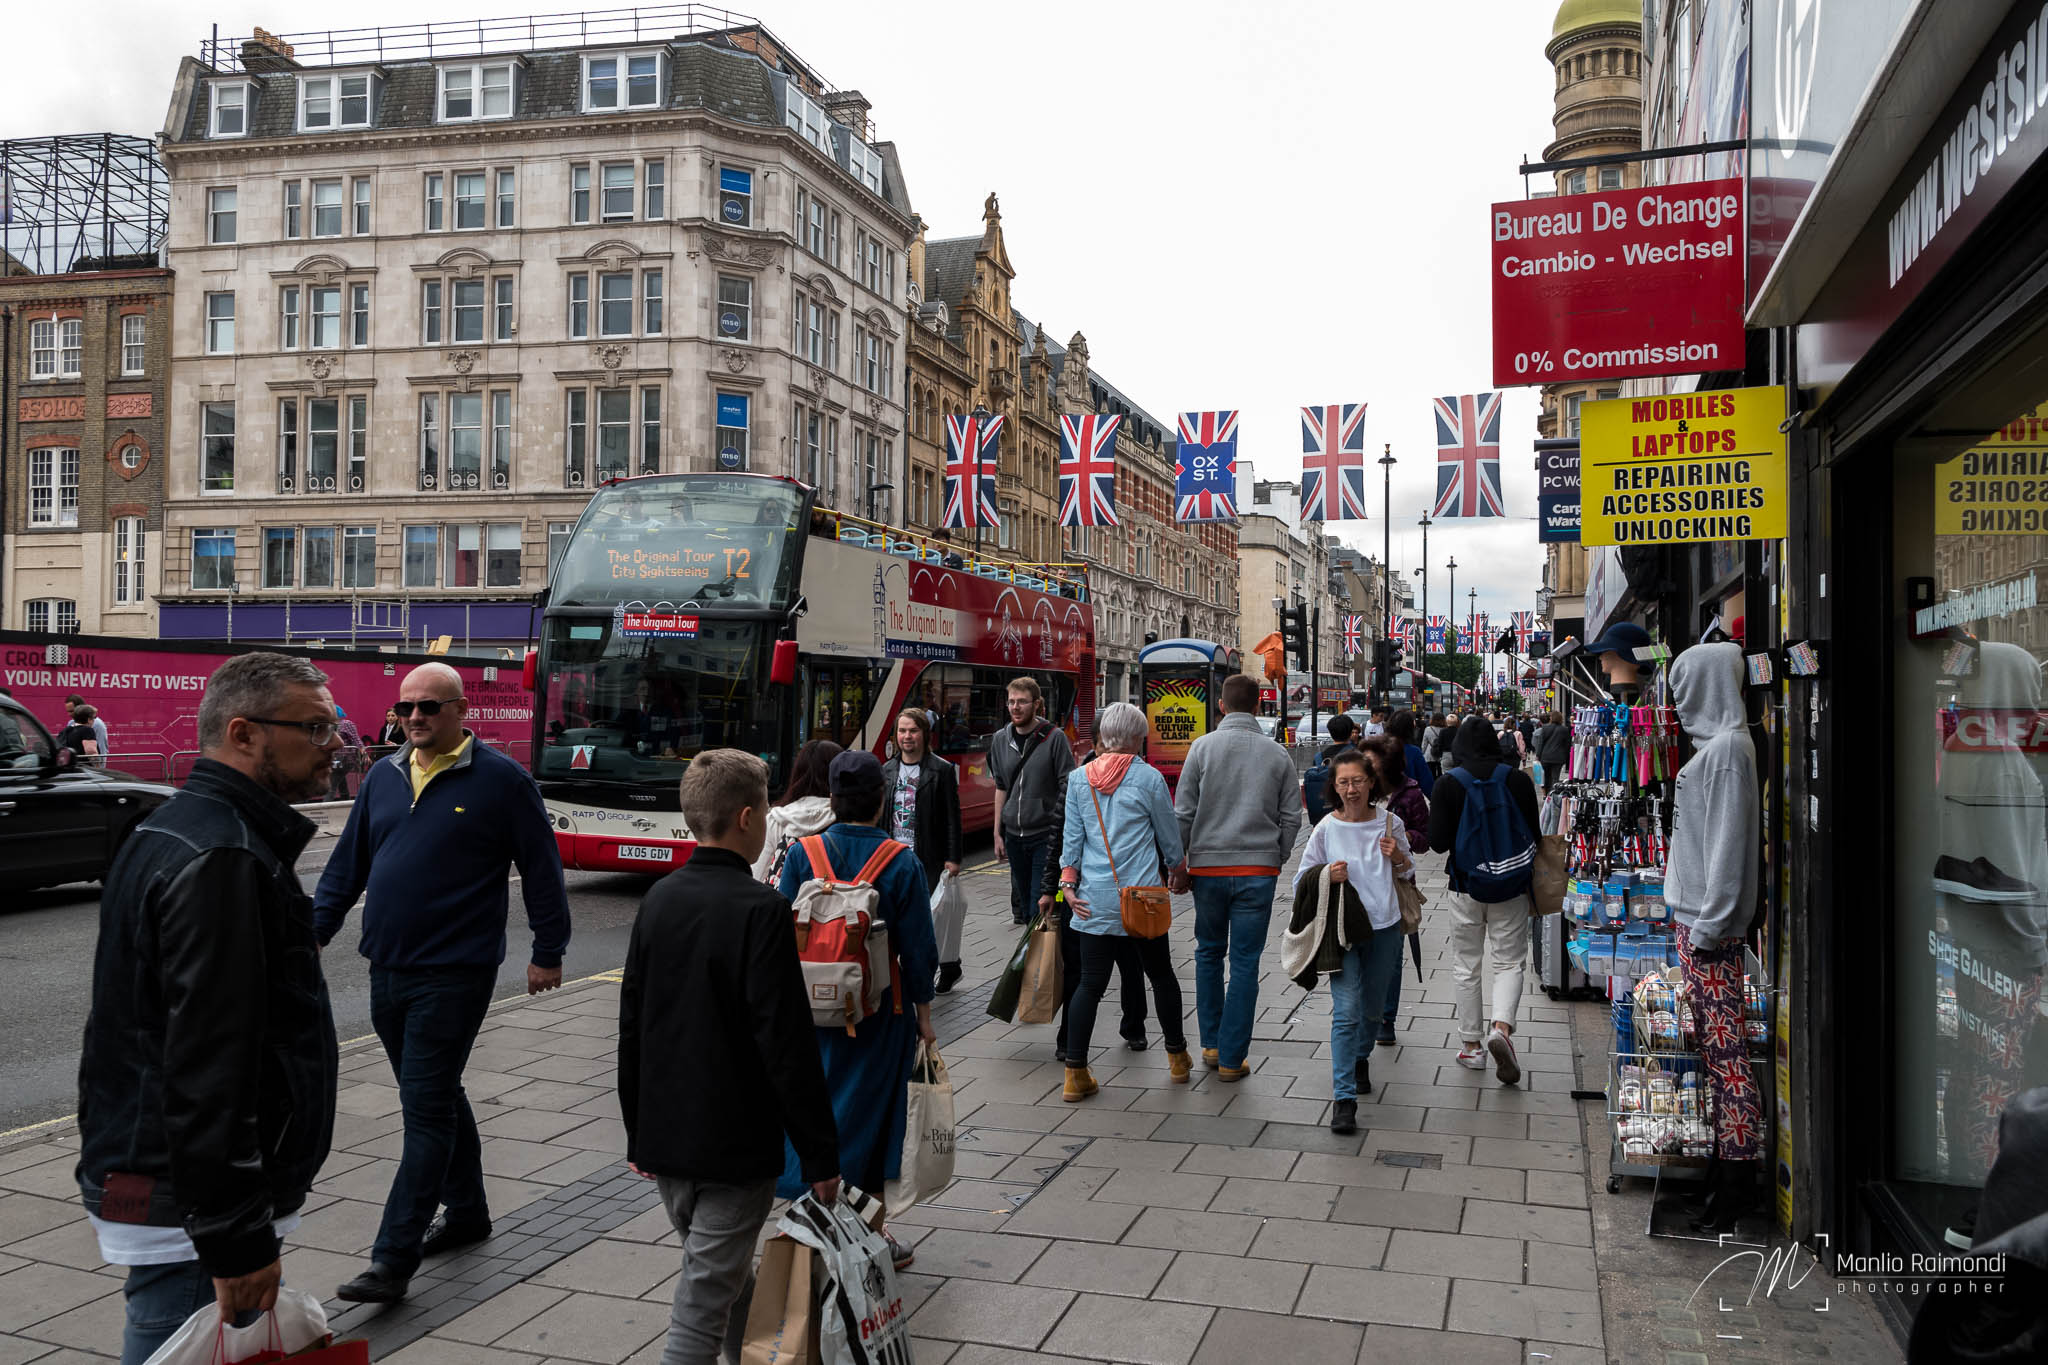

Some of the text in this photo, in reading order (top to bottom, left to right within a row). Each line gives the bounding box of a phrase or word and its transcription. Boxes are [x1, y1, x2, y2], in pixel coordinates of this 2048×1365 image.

[1495, 194, 1737, 241] Bureau De Change
[1502, 250, 1595, 278] Cambio
[1622, 234, 1732, 266] Wechsel
[1514, 340, 1718, 374] 0% Commission
[29, 399, 79, 418] SOHO
[1632, 394, 1735, 423] MOBILES
[1678, 420, 1688, 432] &
[1632, 429, 1736, 458] LAPTOPS
[722, 452, 738, 460] mse
[1192, 456, 1218, 468] OX
[1192, 468, 1218, 480] ST.
[1544, 476, 1562, 488] PC
[1614, 460, 1750, 490] REPAIRING
[1602, 487, 1764, 516] ACCESSORIES
[1614, 515, 1751, 542] UNLOCKING
[608, 548, 716, 564] The Original Tour
[722, 548, 750, 578] T2
[612, 564, 709, 578] City Sightseeing
[627, 614, 696, 630] The Original Tour
[890, 601, 954, 640] The Original Tour
[886, 642, 956, 659] London Sightseeing
[4, 670, 207, 691] YOUR NEW EAST TO WEST
[478, 682, 518, 693] BRINGING
[468, 695, 528, 706] ILLION PEOPLE
[482, 708, 493, 720] TO
[495, 708, 528, 720] LONDON
[1156, 724, 1194, 732] CULTURE
[1162, 732, 1190, 740] CLASH
[572, 810, 634, 820] RATP GROUP
[672, 829, 690, 839] VLY
[621, 846, 670, 860] LX05 GDV
[1928, 930, 2023, 1004] SHOE GALLERY
